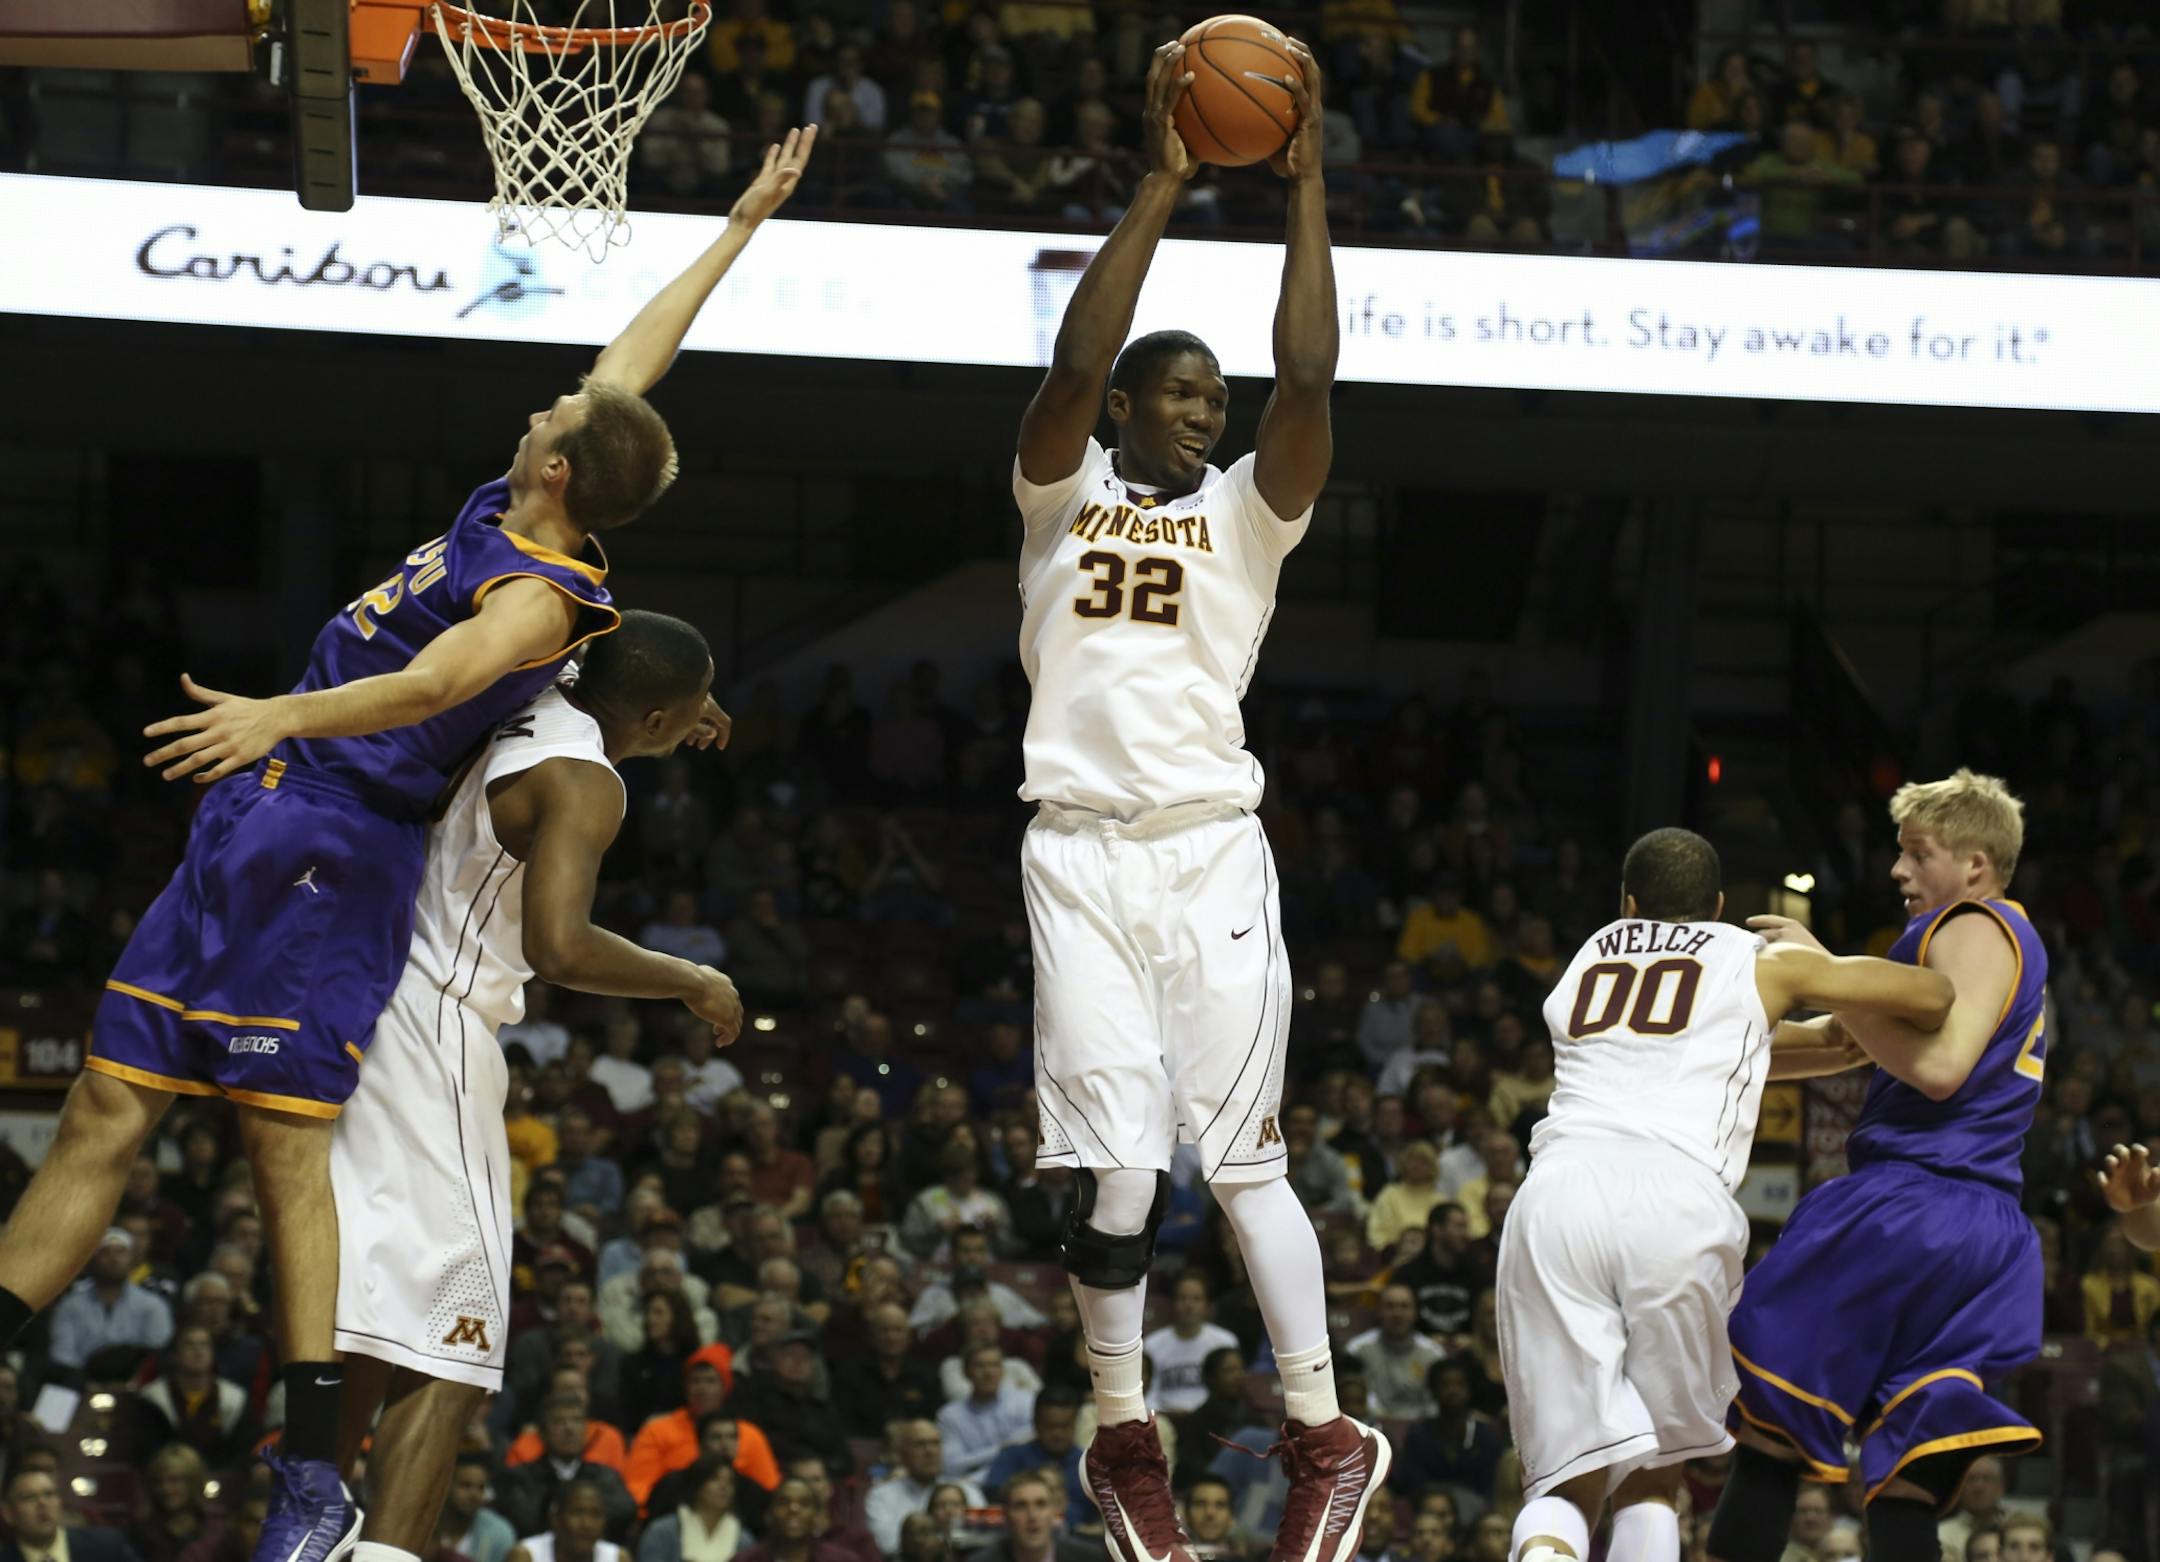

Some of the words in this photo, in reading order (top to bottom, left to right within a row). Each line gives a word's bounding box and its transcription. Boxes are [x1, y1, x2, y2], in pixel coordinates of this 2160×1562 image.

[136, 224, 452, 292] Caribou
[1346, 292, 1407, 338] ife
[1423, 300, 1456, 340] is
[1474, 299, 1609, 346] short.
[1627, 307, 1728, 363] Stay
[1743, 312, 1892, 356] awake
[1909, 313, 1977, 361] for
[1073, 551, 1185, 628] 32
[1596, 922, 1716, 958] WELCH
[1568, 958, 1704, 1039] 00
[442, 1315, 491, 1352] M
